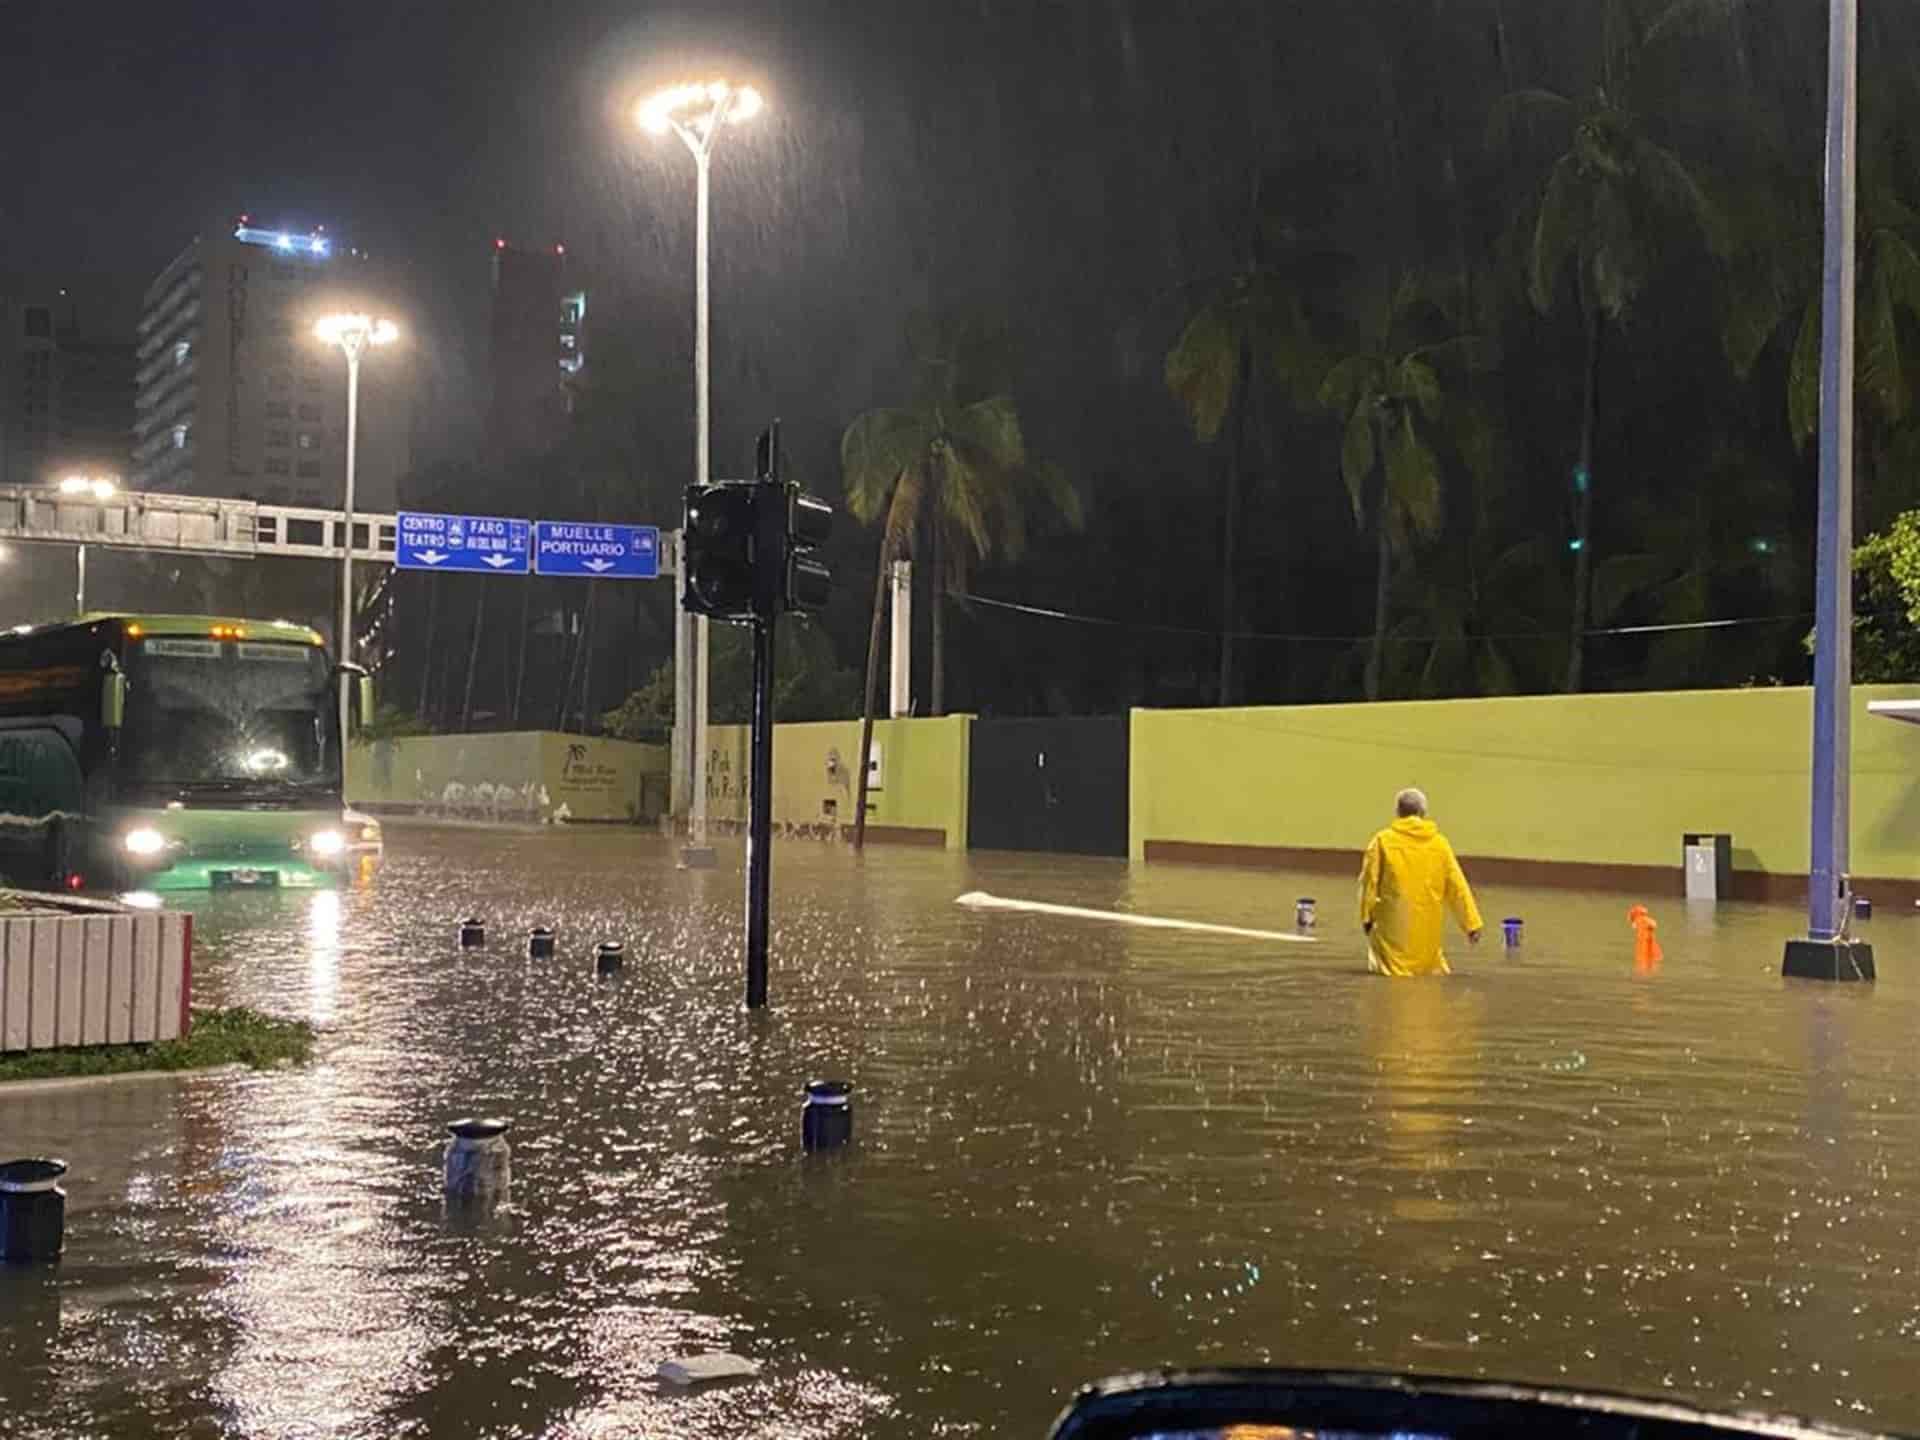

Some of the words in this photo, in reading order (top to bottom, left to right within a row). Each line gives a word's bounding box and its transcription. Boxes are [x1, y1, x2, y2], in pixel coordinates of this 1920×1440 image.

[403, 516, 445, 531] CENTRO
[470, 520, 505, 535] FARO
[403, 532, 445, 547] TEATRO
[551, 526, 614, 541] MUELLE
[541, 541, 625, 556] PORTUARIO
